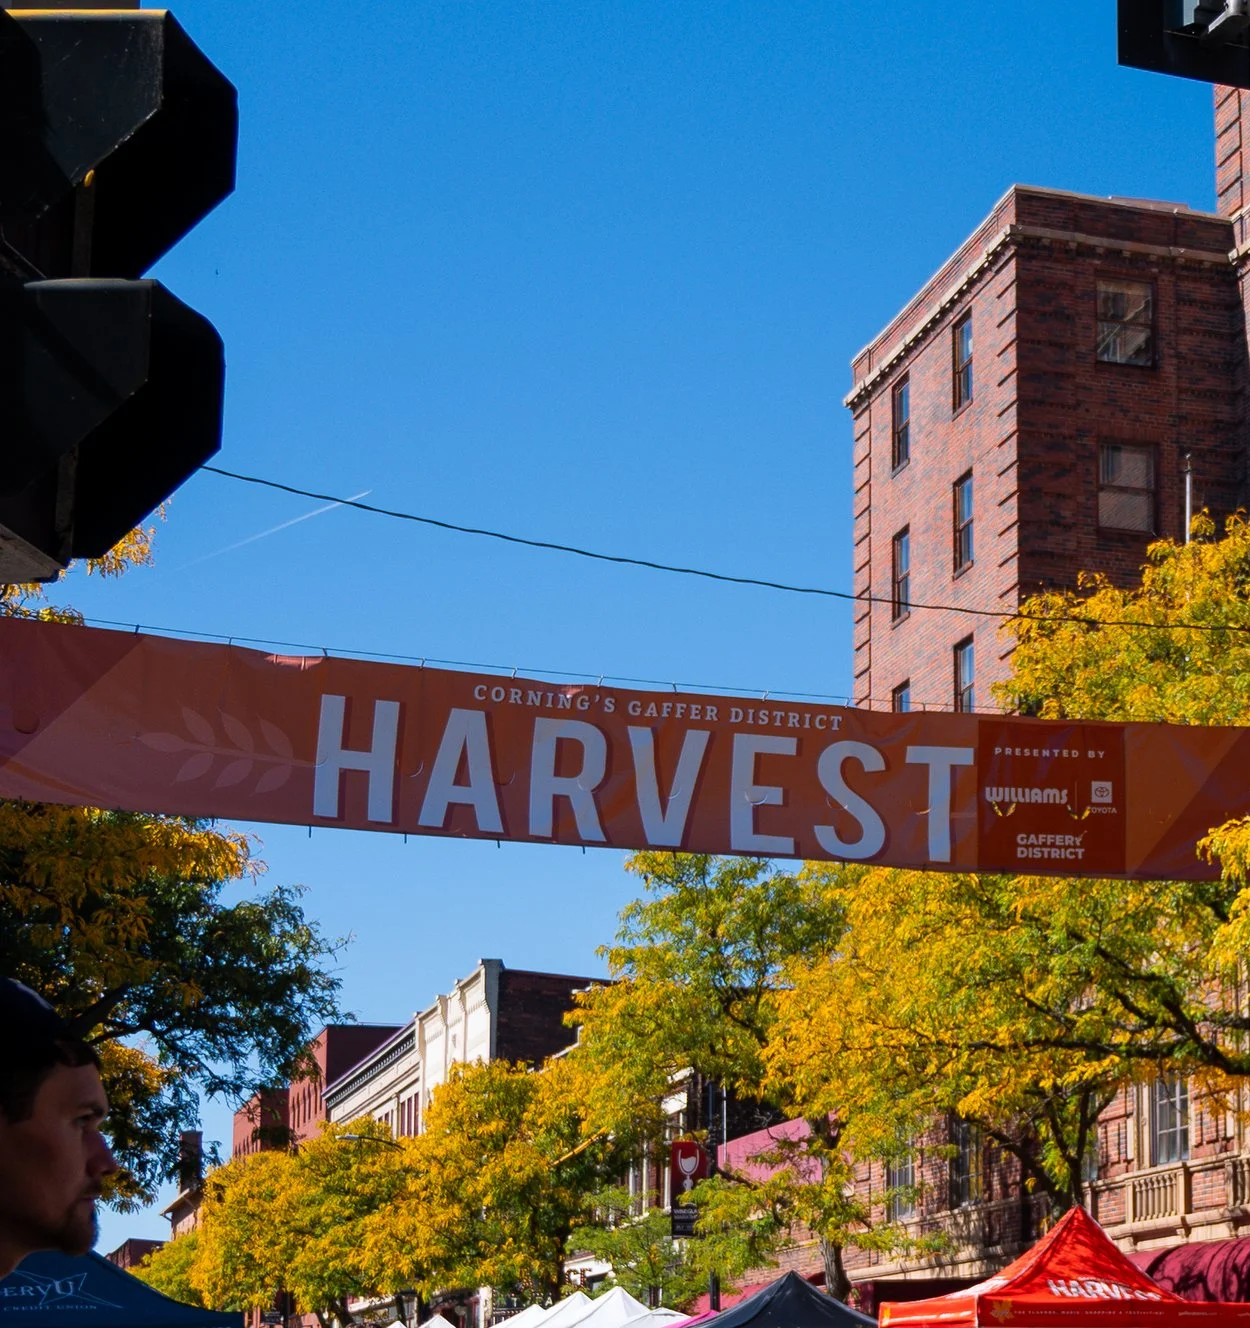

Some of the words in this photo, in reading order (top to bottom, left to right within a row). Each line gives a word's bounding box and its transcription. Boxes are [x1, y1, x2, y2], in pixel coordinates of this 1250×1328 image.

[628, 700, 719, 722] GAFFER
[730, 707, 844, 731] DISTRICT
[994, 747, 1079, 758] PRESENTED
[1087, 751, 1105, 759] BY
[312, 693, 974, 864] HARVEST
[1089, 806, 1118, 814] OYOTA
[1016, 847, 1085, 860] DISTRICT
